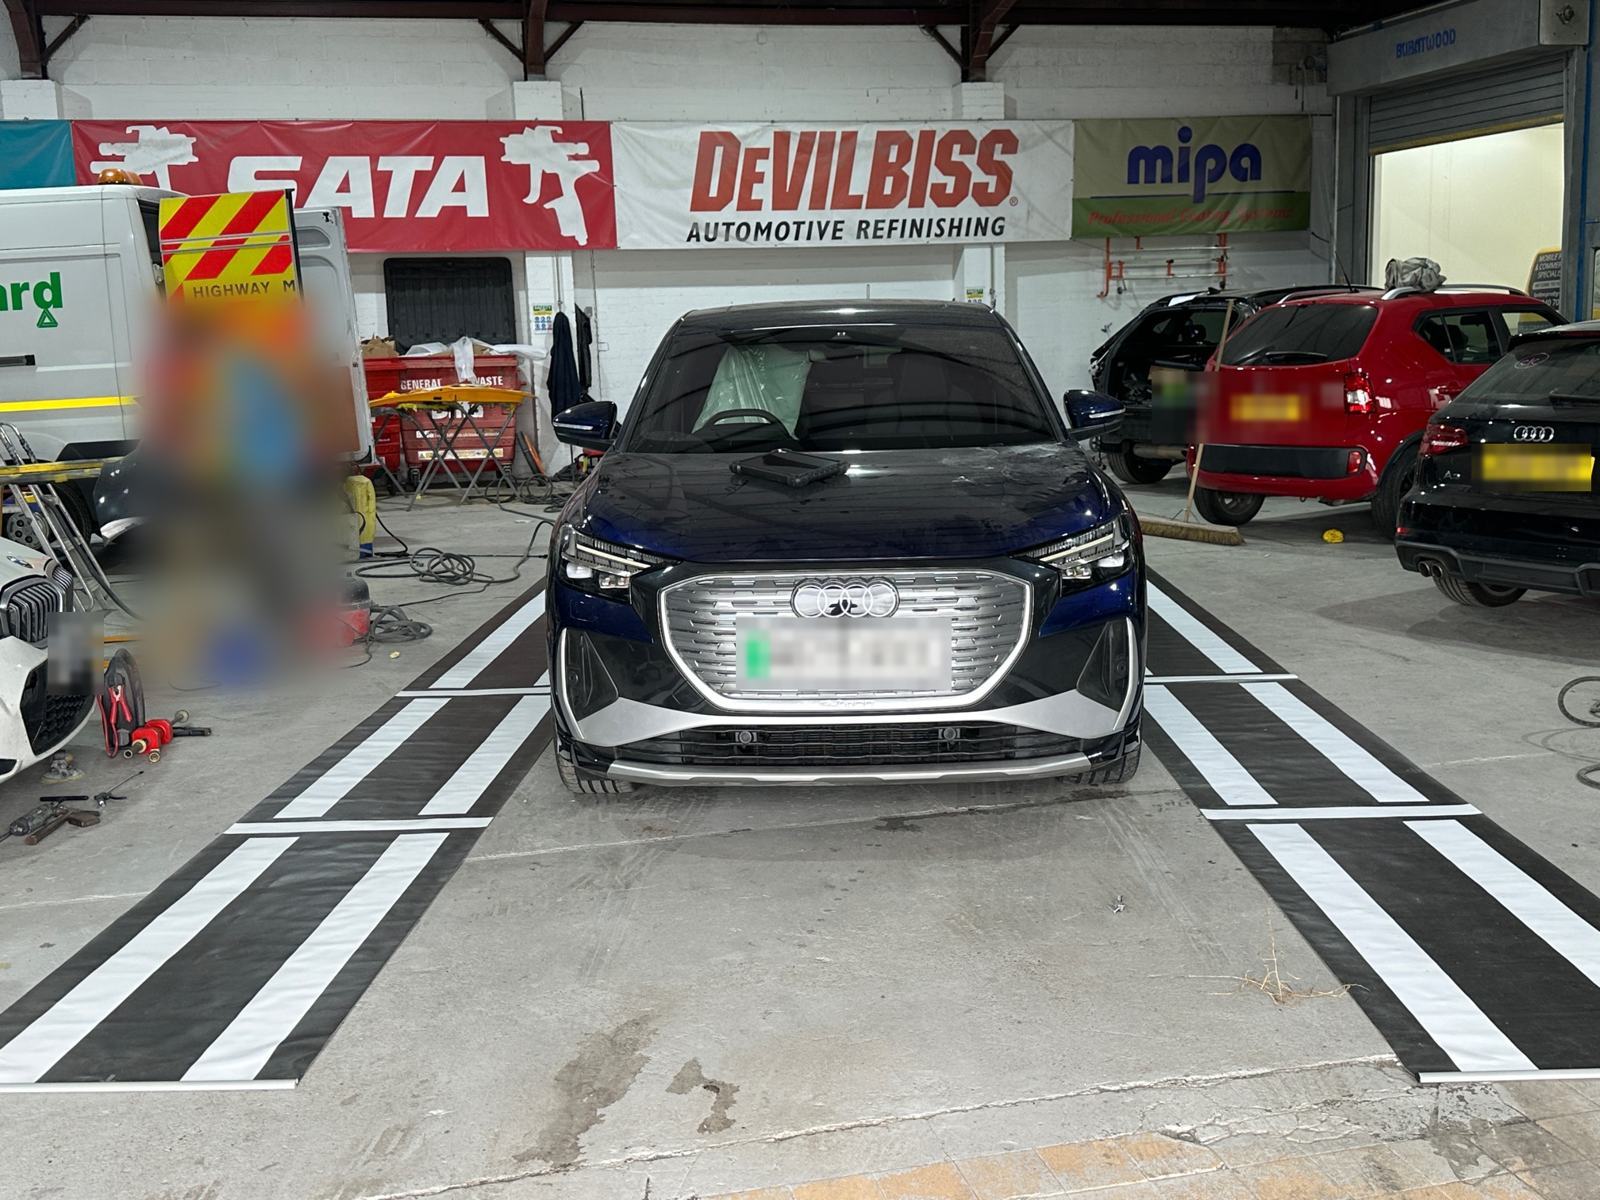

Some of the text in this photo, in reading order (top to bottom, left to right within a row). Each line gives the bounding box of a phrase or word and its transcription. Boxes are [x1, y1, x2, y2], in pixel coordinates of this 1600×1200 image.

[1127, 126, 1262, 203] mipa
[227, 155, 490, 218] SATA
[686, 216, 1006, 243] AUTOMOTIVE REFINISHING
[193, 281, 270, 298] HIGHWAY
[400, 378, 441, 390] GENERAL
